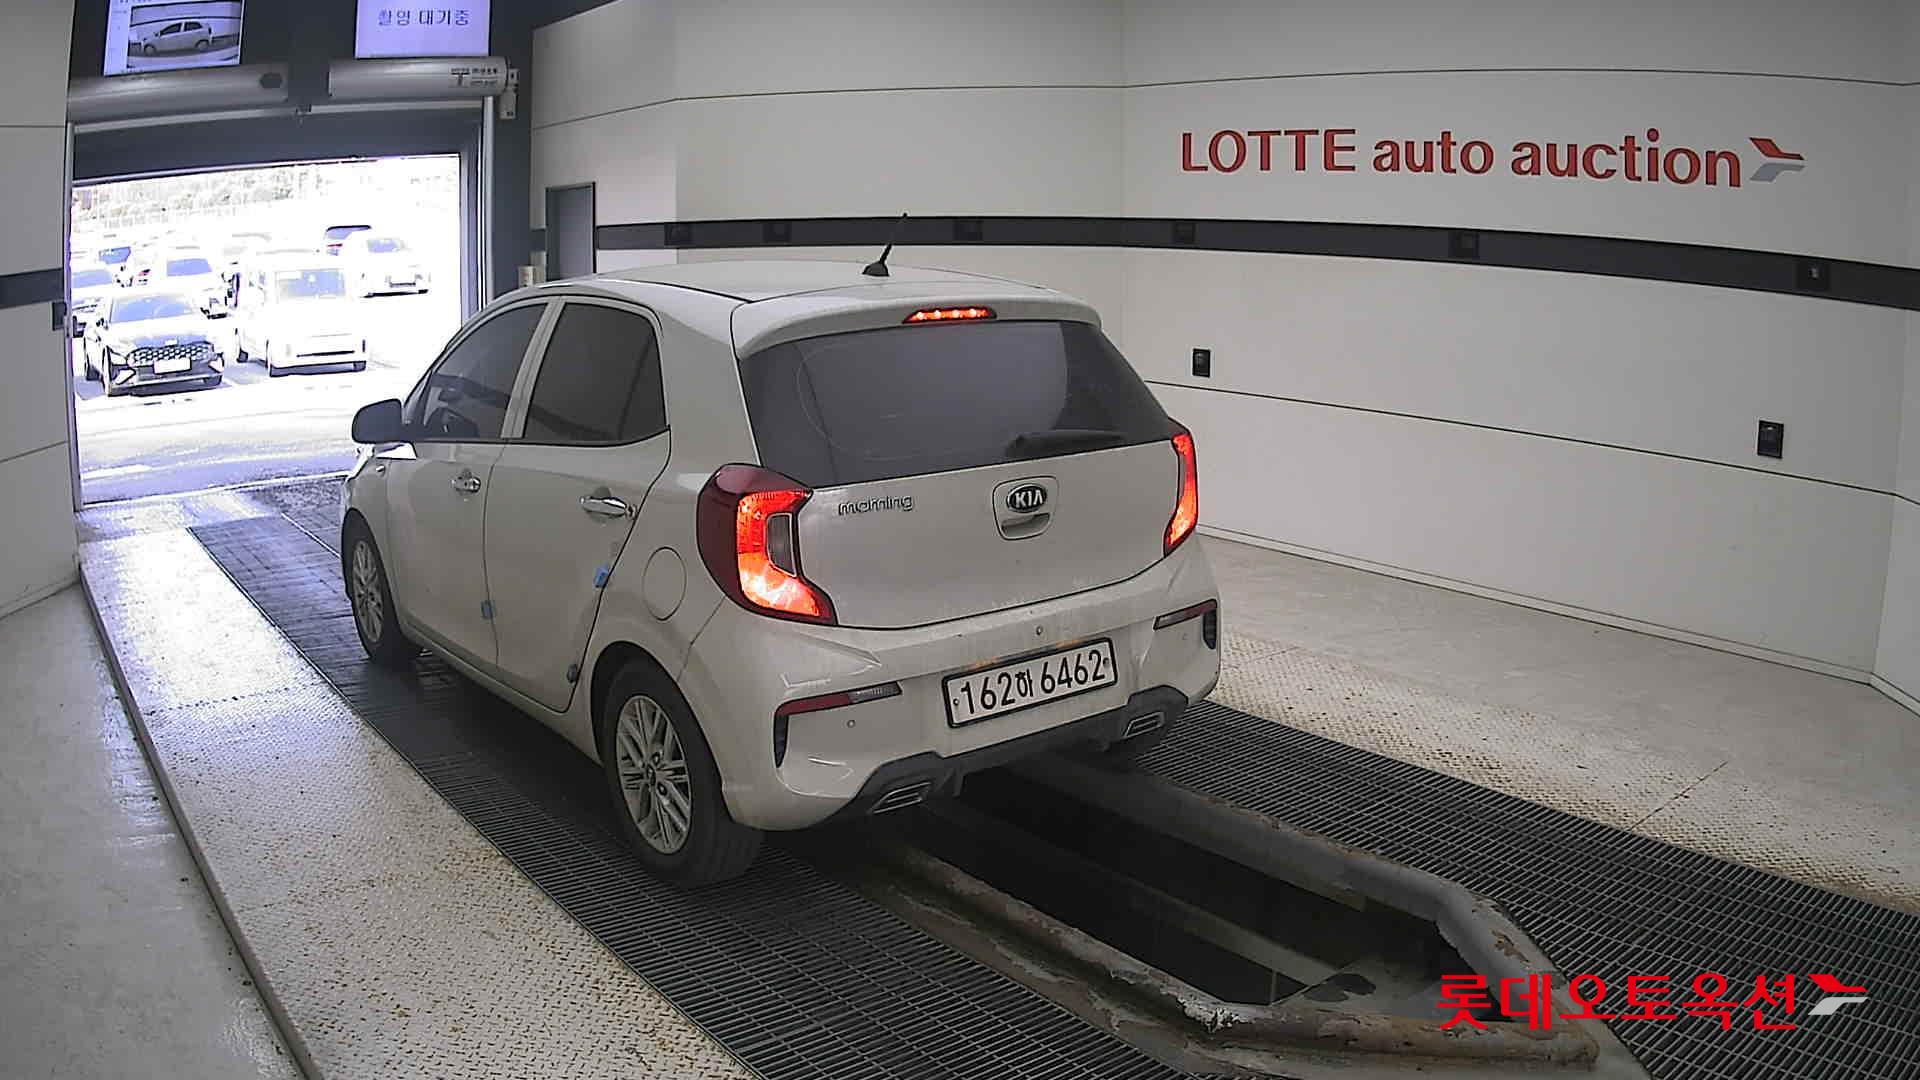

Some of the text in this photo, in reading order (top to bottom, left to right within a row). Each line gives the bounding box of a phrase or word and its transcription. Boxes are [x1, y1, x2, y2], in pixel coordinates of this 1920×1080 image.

[419, 9, 469, 26] 대기중
[1181, 127, 1742, 188] LOTTE auto auction
[838, 495, 913, 516] morning
[1013, 488, 1044, 509] KIA
[960, 649, 1106, 715] 162하 6462
